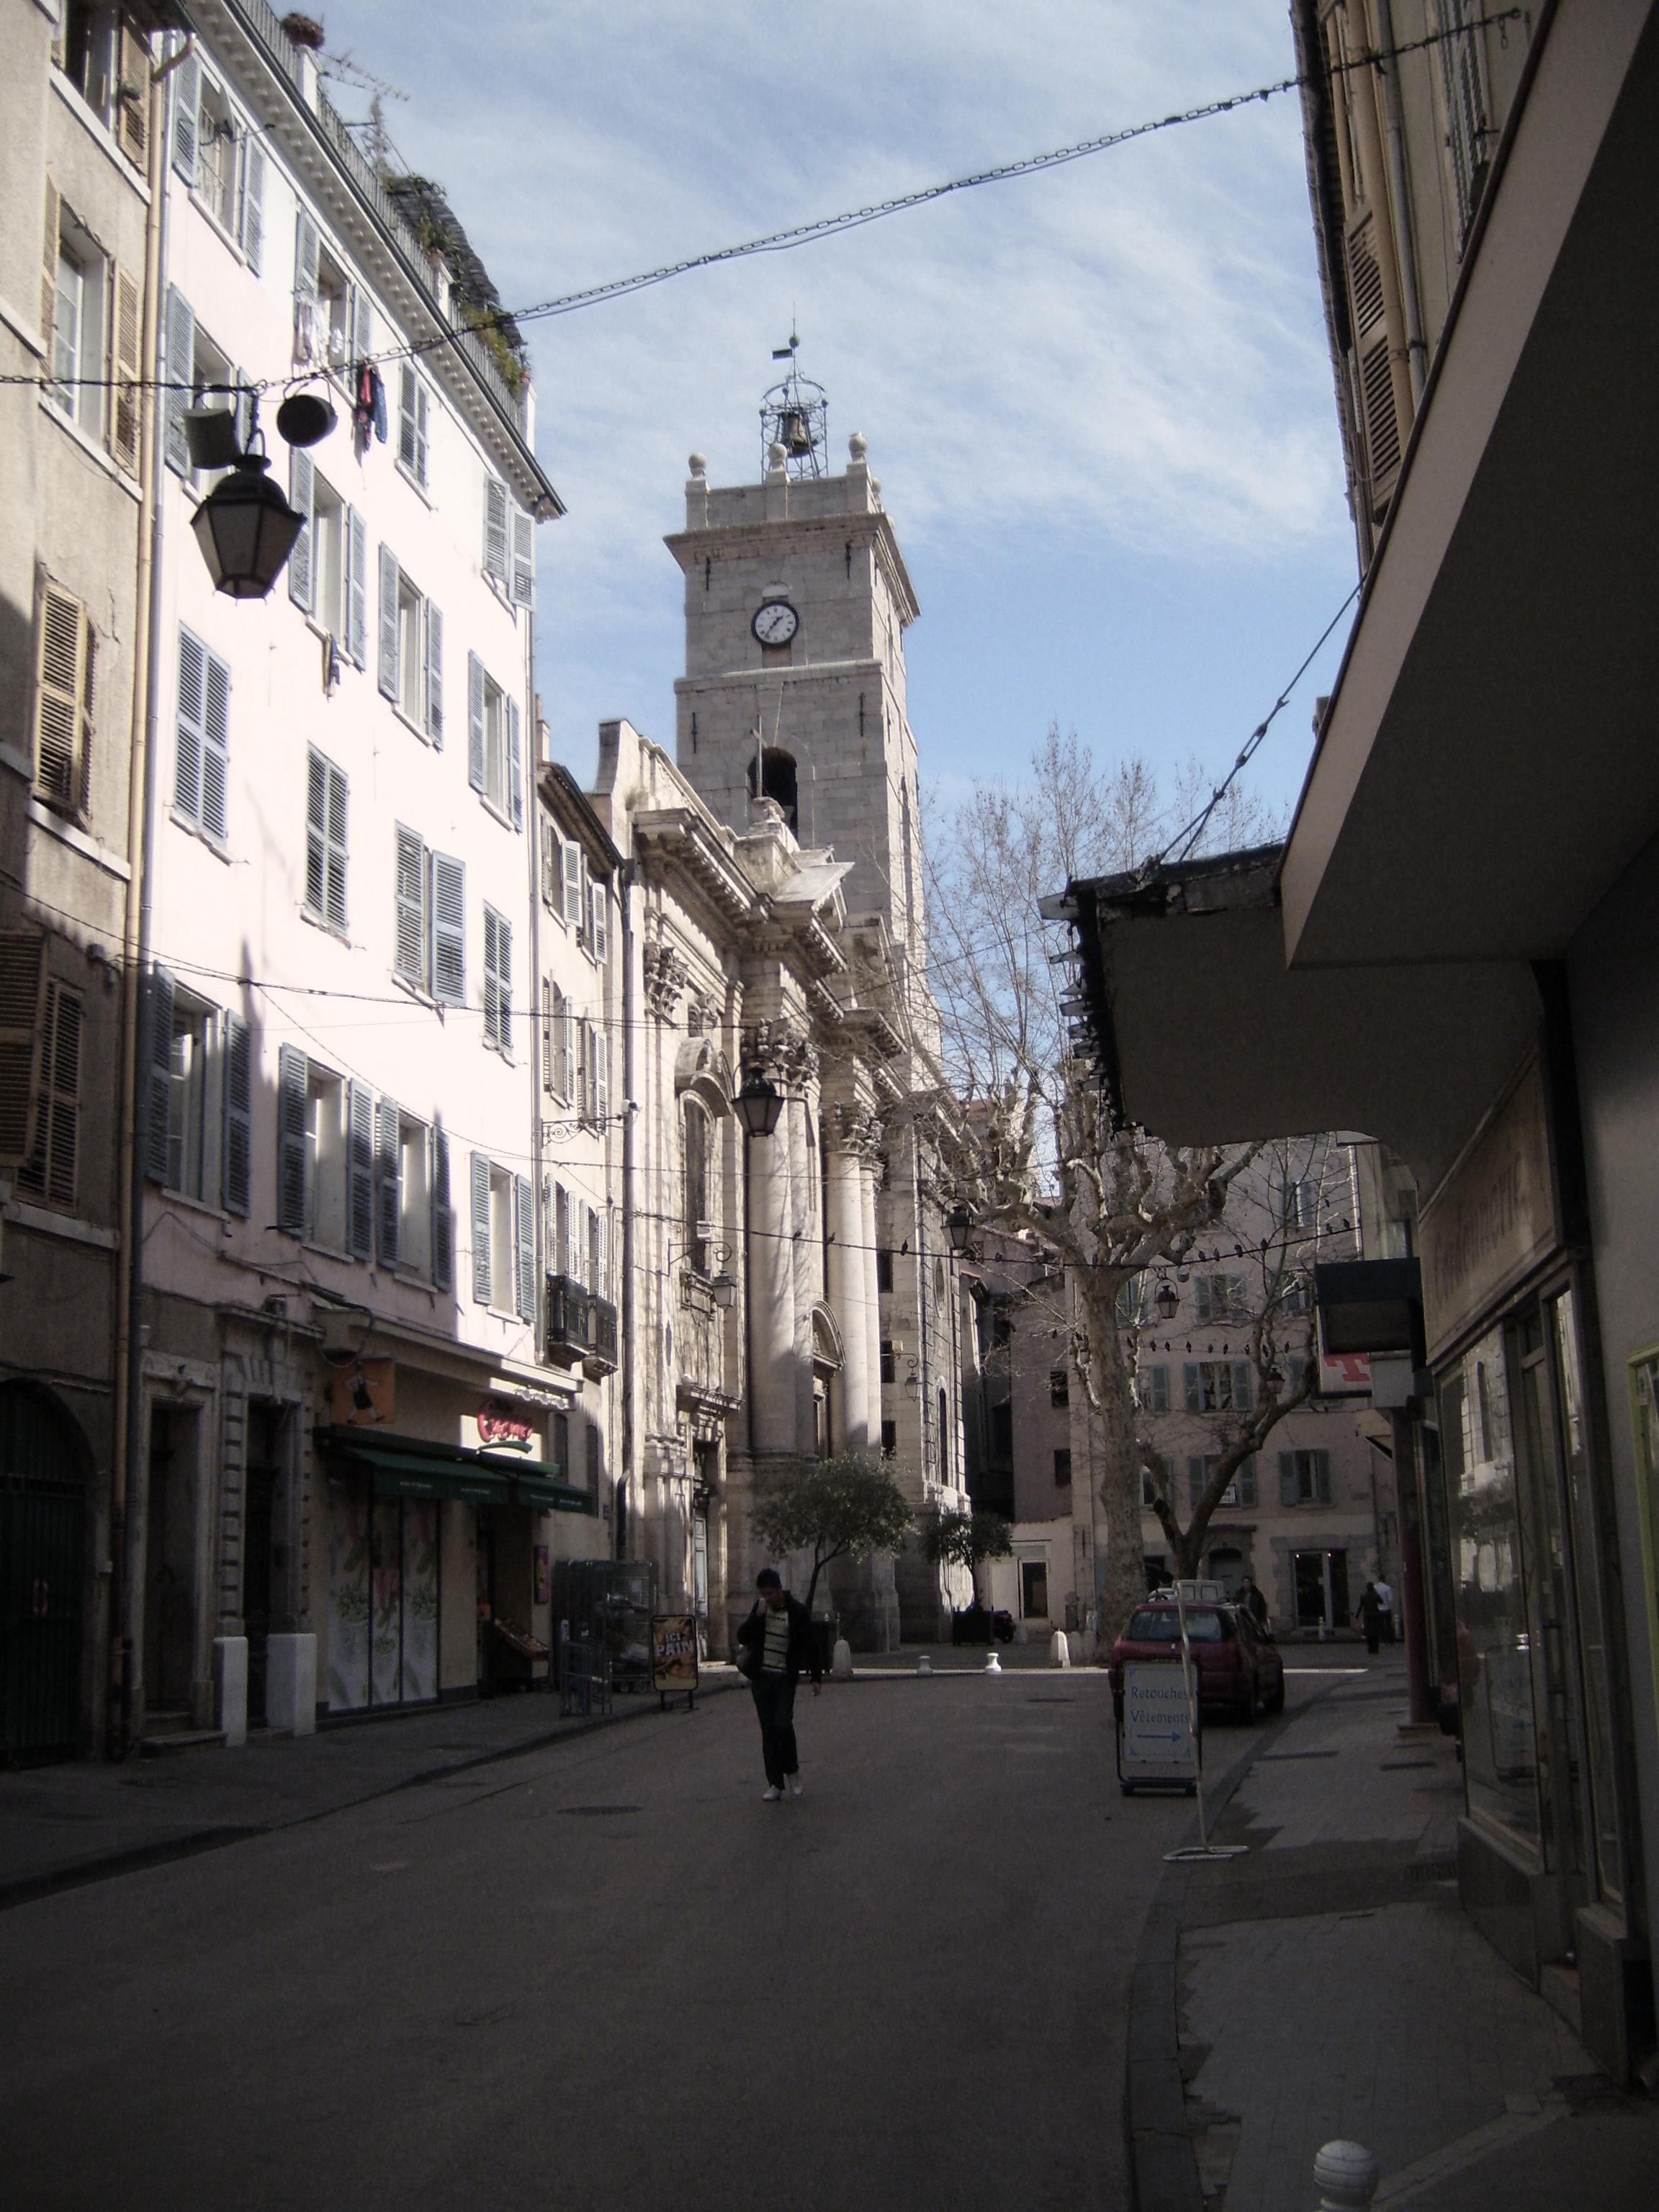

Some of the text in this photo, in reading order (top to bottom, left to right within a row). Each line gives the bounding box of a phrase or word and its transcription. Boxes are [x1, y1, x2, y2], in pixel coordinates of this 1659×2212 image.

[656, 1641, 693, 1656] PAIN
[1131, 1686, 1187, 1699] Retouches
[1130, 1711, 1189, 1722] Vêtements
